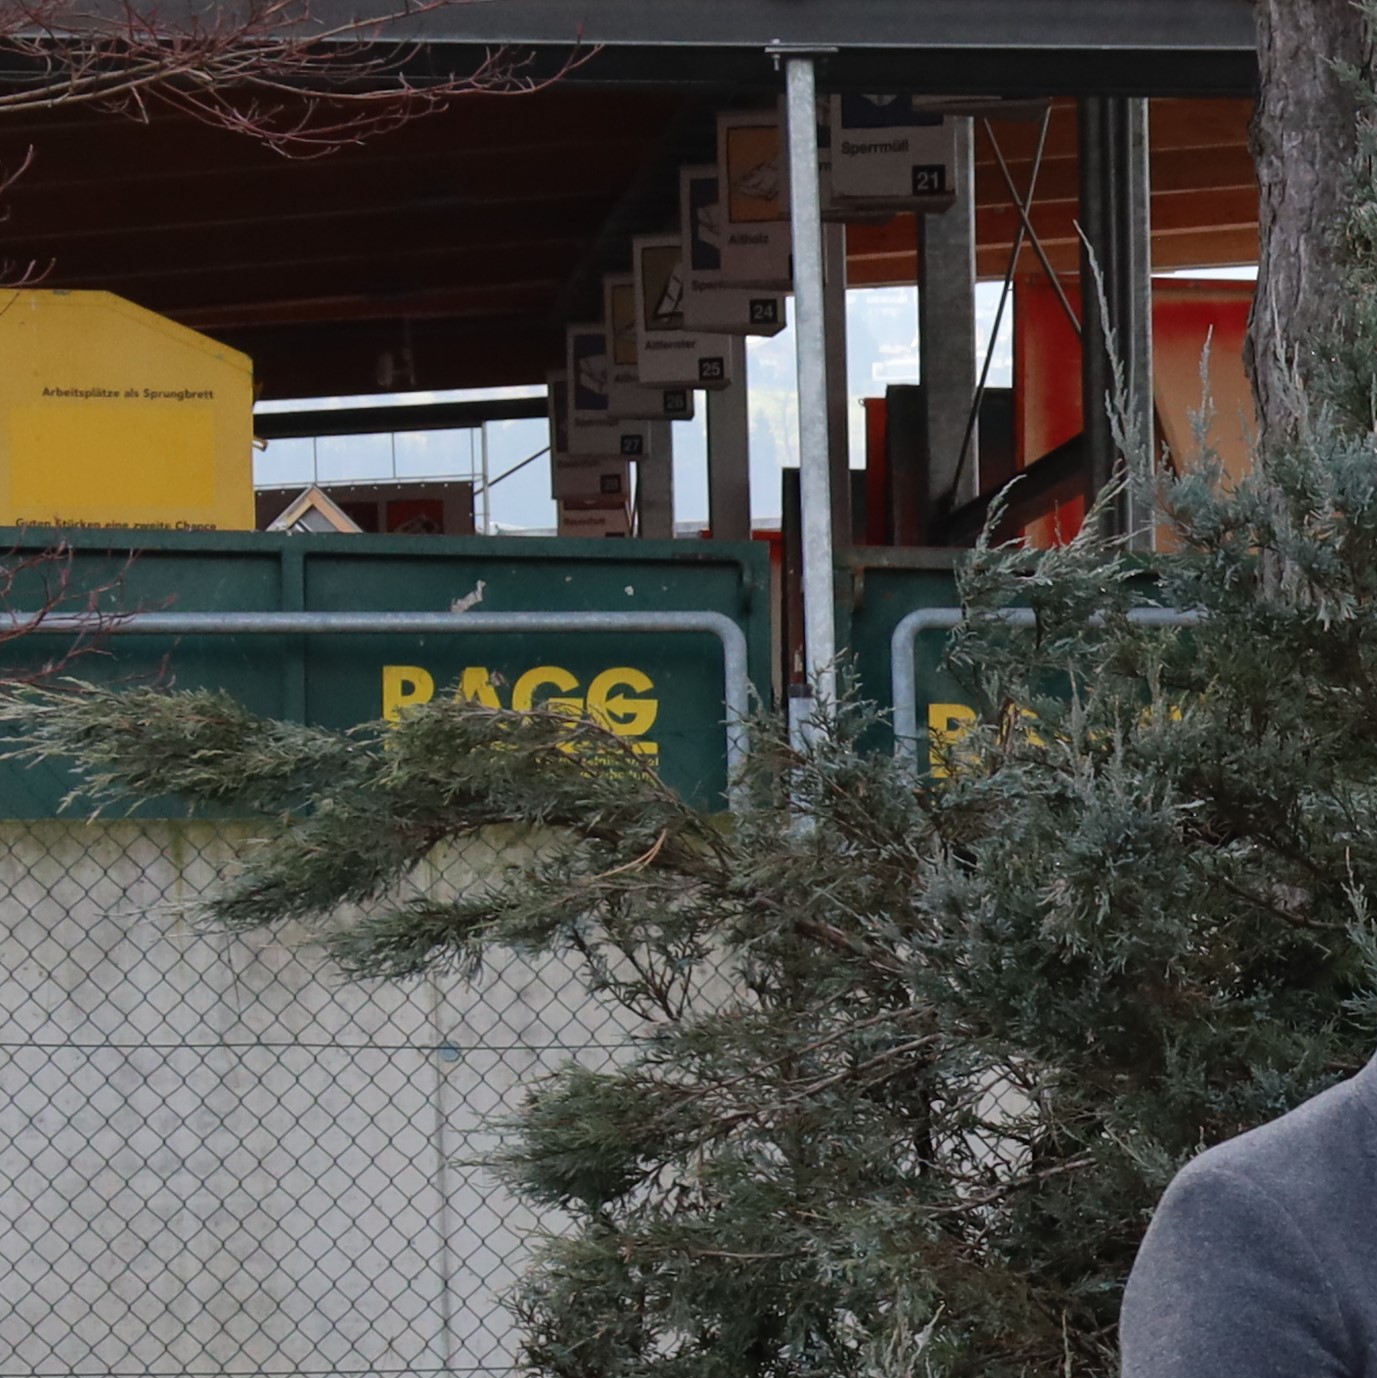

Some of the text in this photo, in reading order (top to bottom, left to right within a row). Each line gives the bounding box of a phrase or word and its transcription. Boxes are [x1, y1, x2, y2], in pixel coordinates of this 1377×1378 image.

[841, 139, 909, 157] Sperrmüll
[915, 170, 940, 191] 21
[752, 303, 775, 320] 24
[701, 362, 721, 377] 25
[42, 387, 214, 401] Arbeitsplätze als Sprungbrett
[623, 439, 641, 451] 27
[16, 518, 51, 528] Guten
[105, 519, 128, 530] eine
[175, 520, 217, 531] Chance
